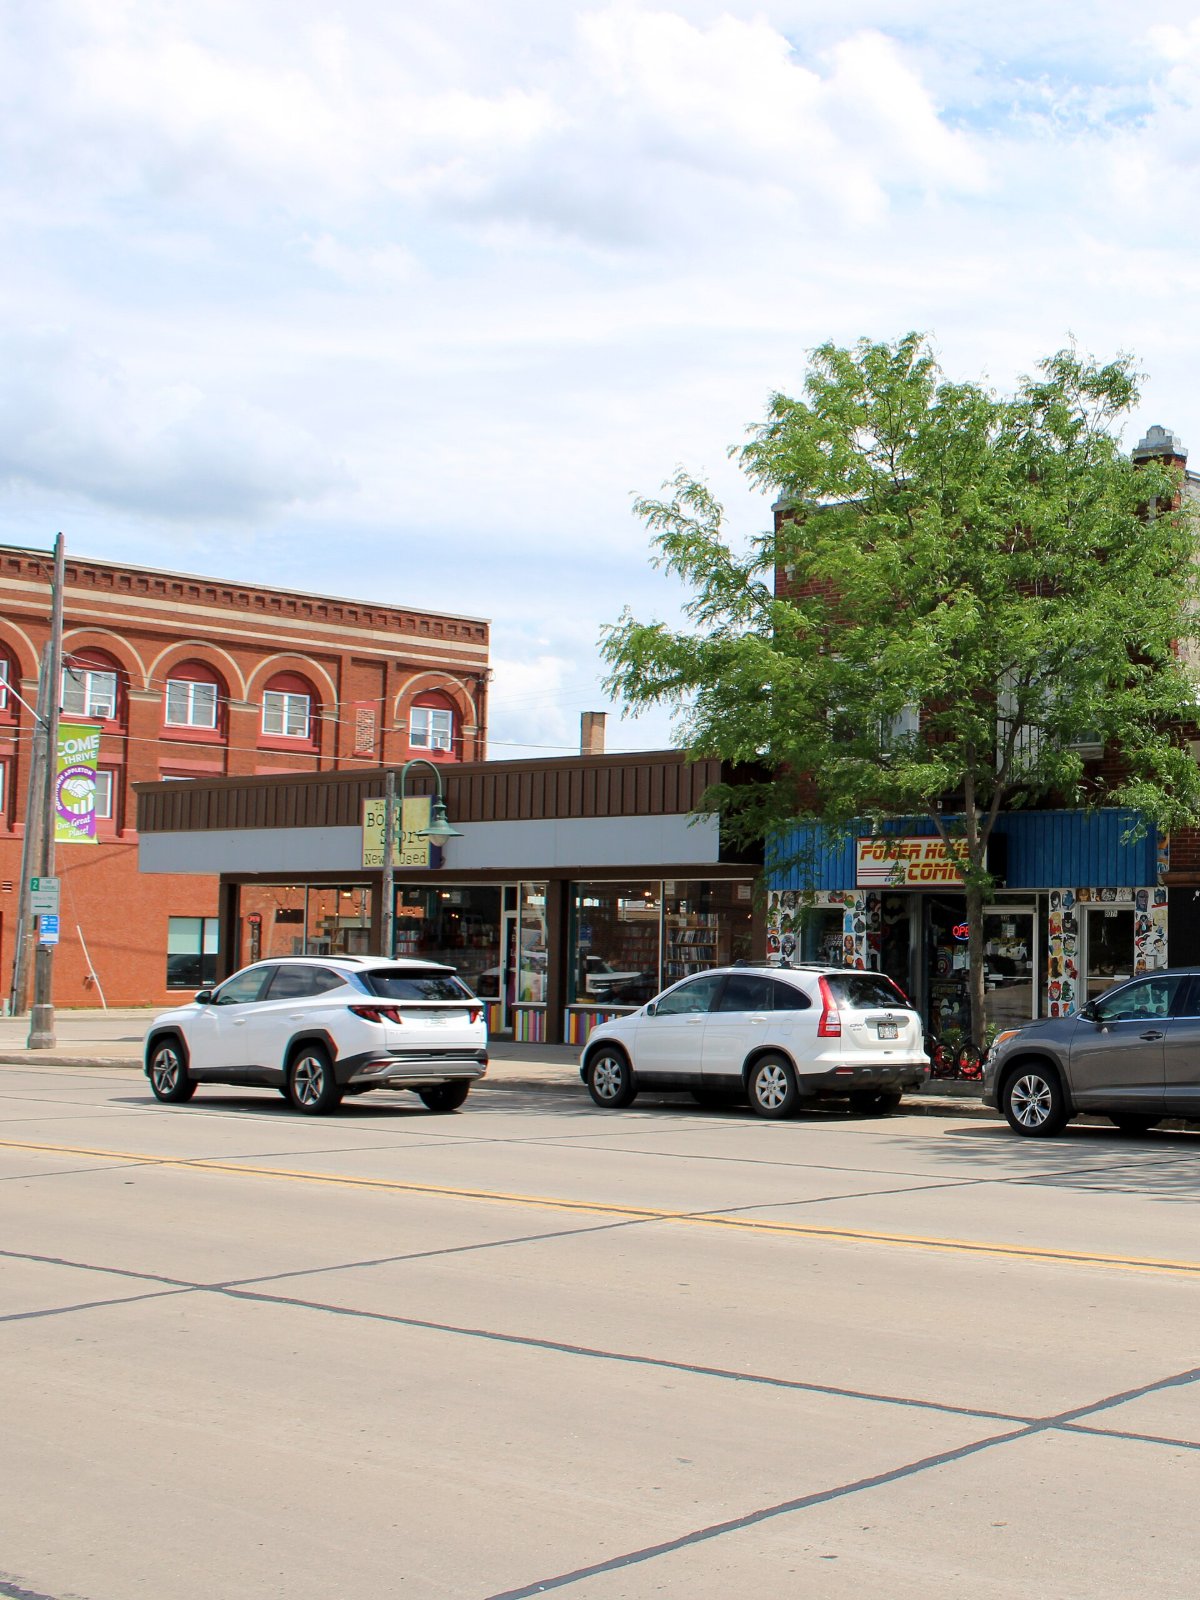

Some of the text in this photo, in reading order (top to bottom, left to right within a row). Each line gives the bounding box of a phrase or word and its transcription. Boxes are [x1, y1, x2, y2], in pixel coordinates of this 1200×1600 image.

[63, 750, 97, 765] THRIVE
[72, 815, 91, 827] Great
[69, 826, 89, 838] Place!
[400, 851, 427, 865] Used
[32, 880, 38, 890] 2
